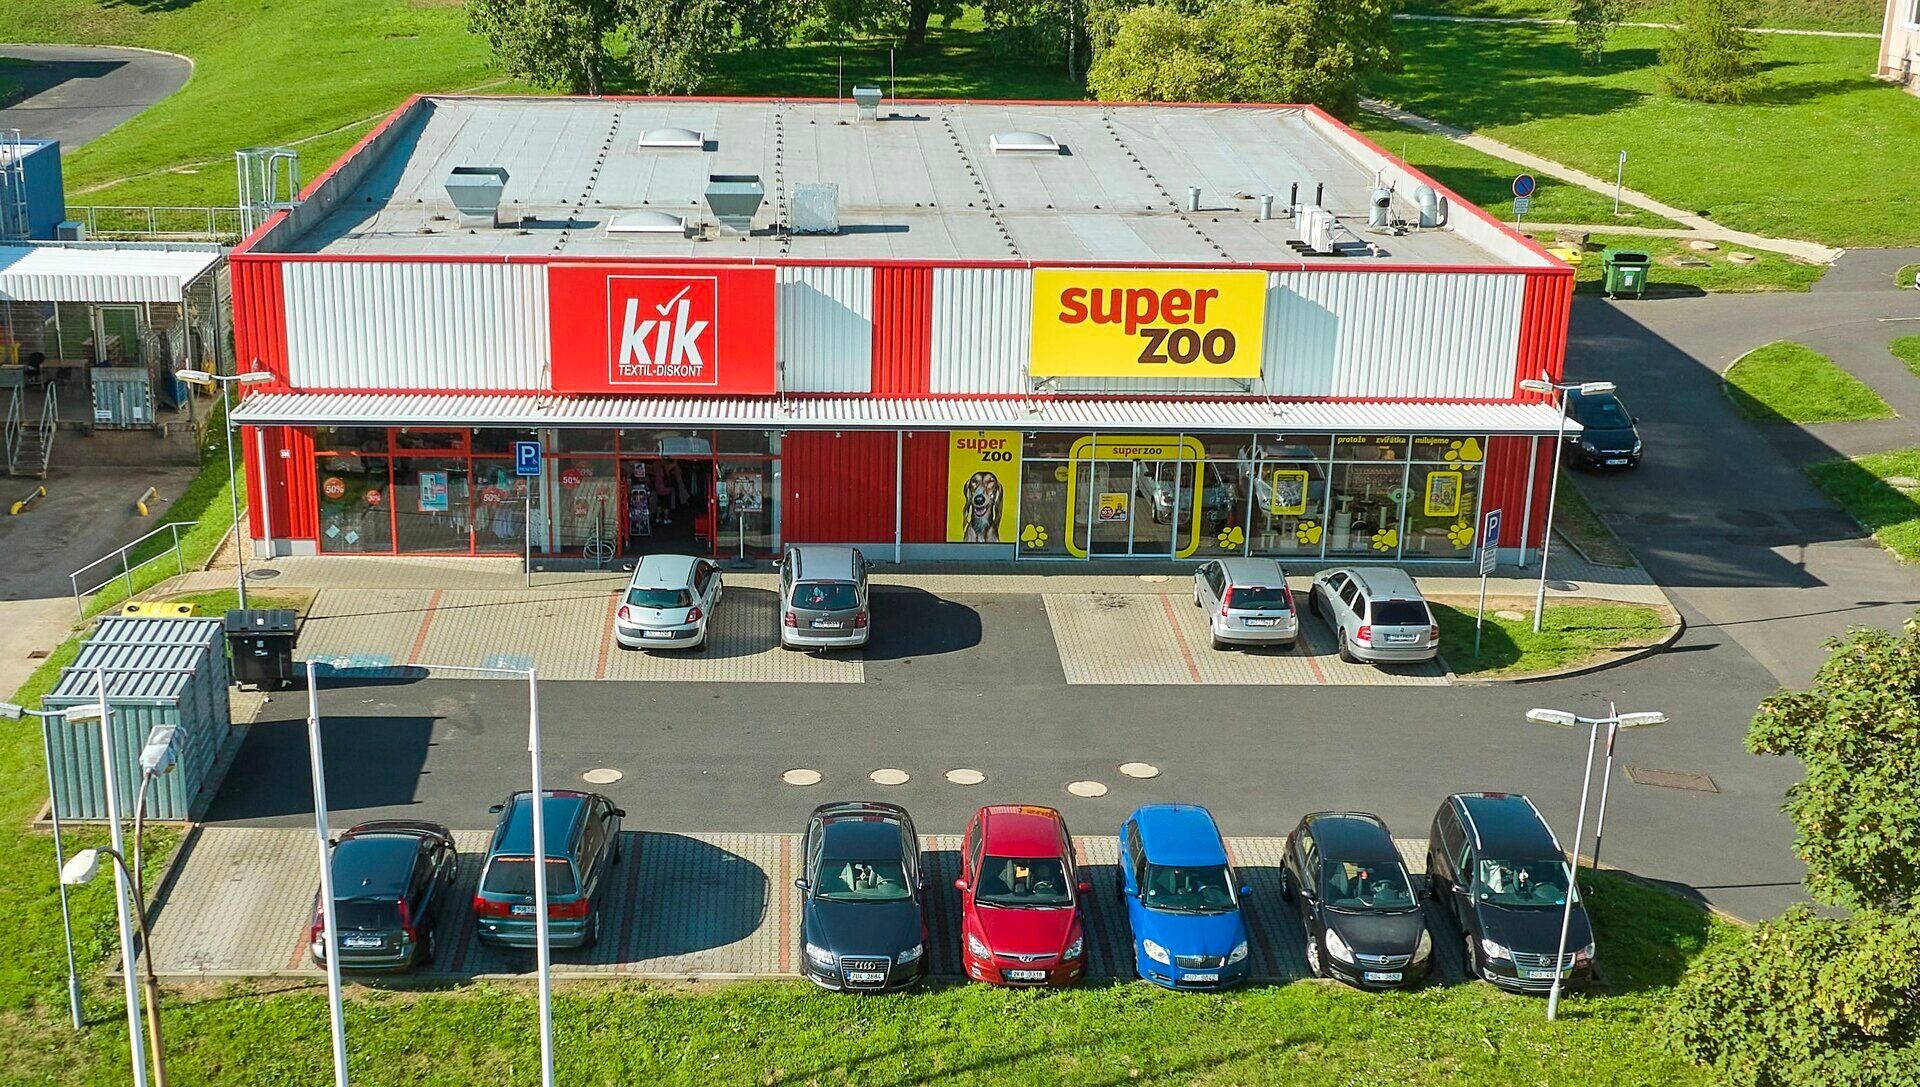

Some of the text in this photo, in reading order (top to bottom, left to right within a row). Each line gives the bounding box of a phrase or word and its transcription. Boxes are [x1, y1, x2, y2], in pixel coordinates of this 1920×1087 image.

[1058, 287, 1219, 335] super
[1137, 328, 1236, 364] zoo
[618, 364, 703, 377] TEXTIL-DISKONT
[956, 438, 1007, 454] super
[1415, 437, 1449, 445] milujeme
[521, 445, 536, 465] P
[981, 451, 1013, 462] zoo
[562, 476, 581, 484] 50%
[325, 485, 345, 494] 50%
[483, 493, 501, 502] 50%
[1488, 516, 1498, 538] P
